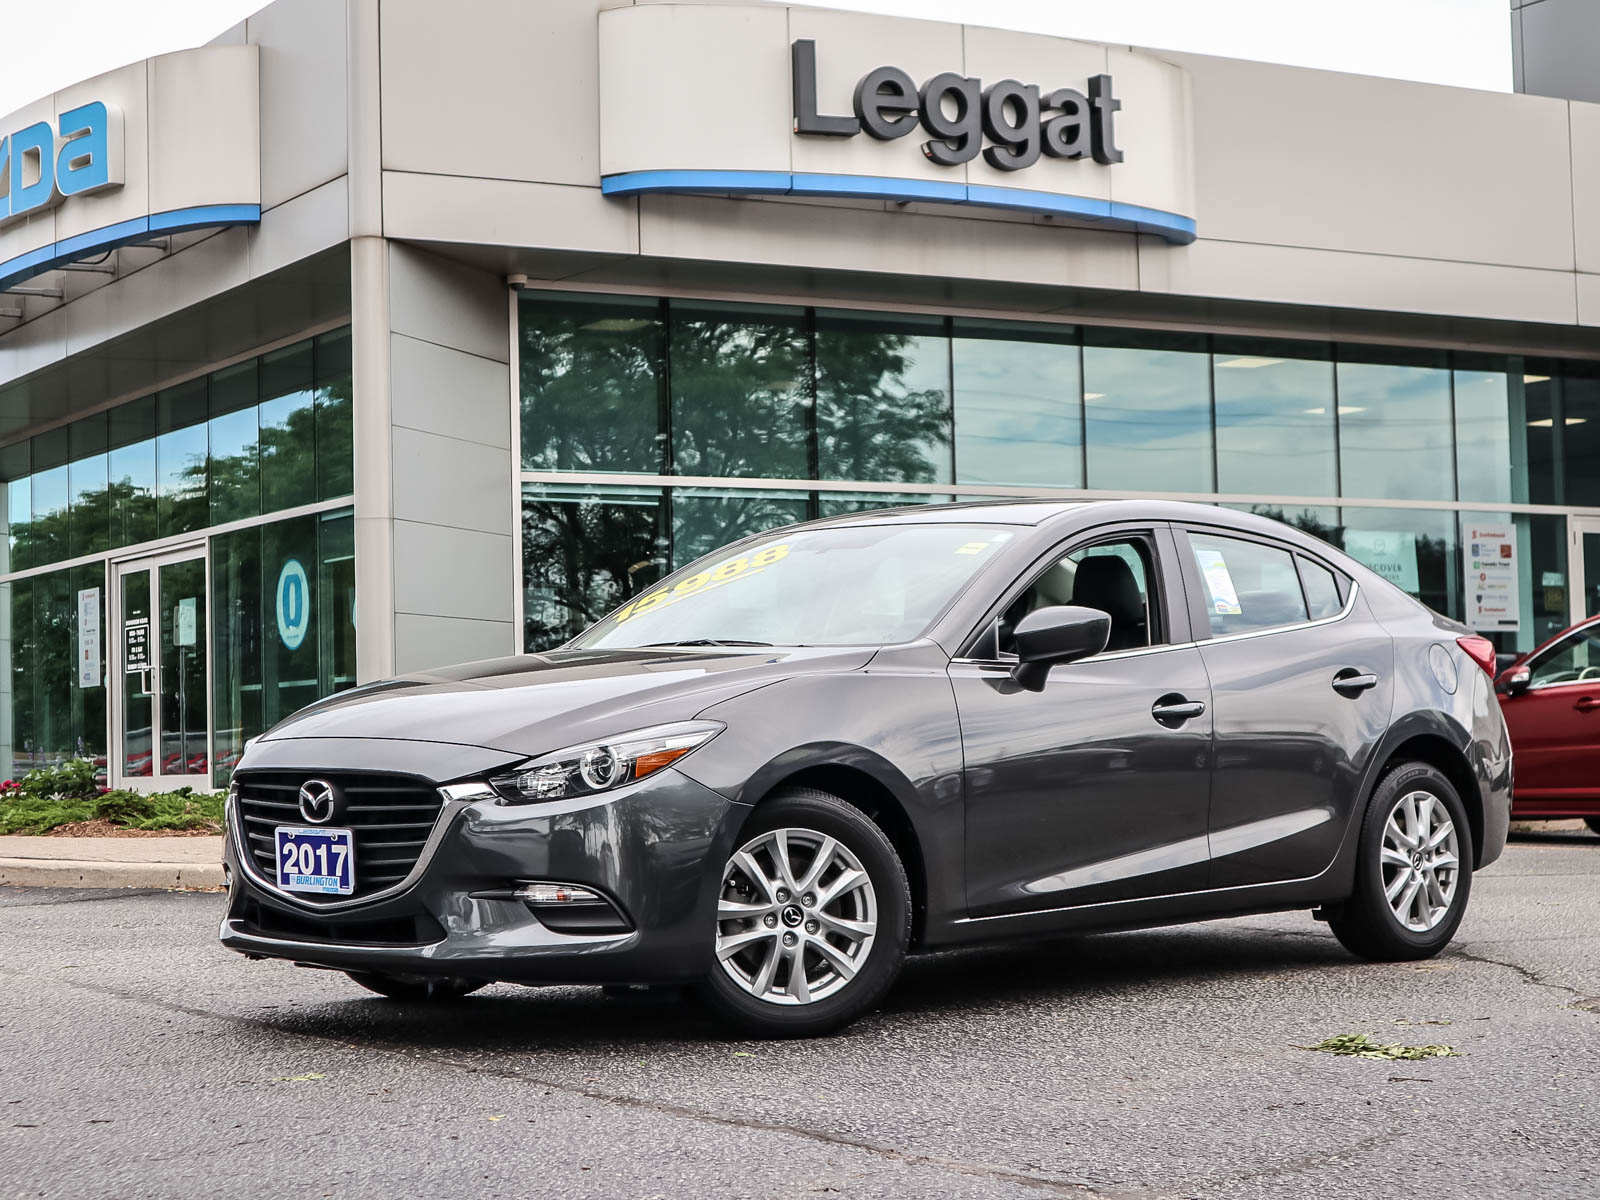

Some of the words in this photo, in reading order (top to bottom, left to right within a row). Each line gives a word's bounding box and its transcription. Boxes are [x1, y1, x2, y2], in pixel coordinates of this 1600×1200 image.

[792, 38, 1125, 172] Leggat
[612, 544, 790, 624] 15988
[283, 842, 347, 877] 2017
[296, 875, 338, 887] BURLINGTON
